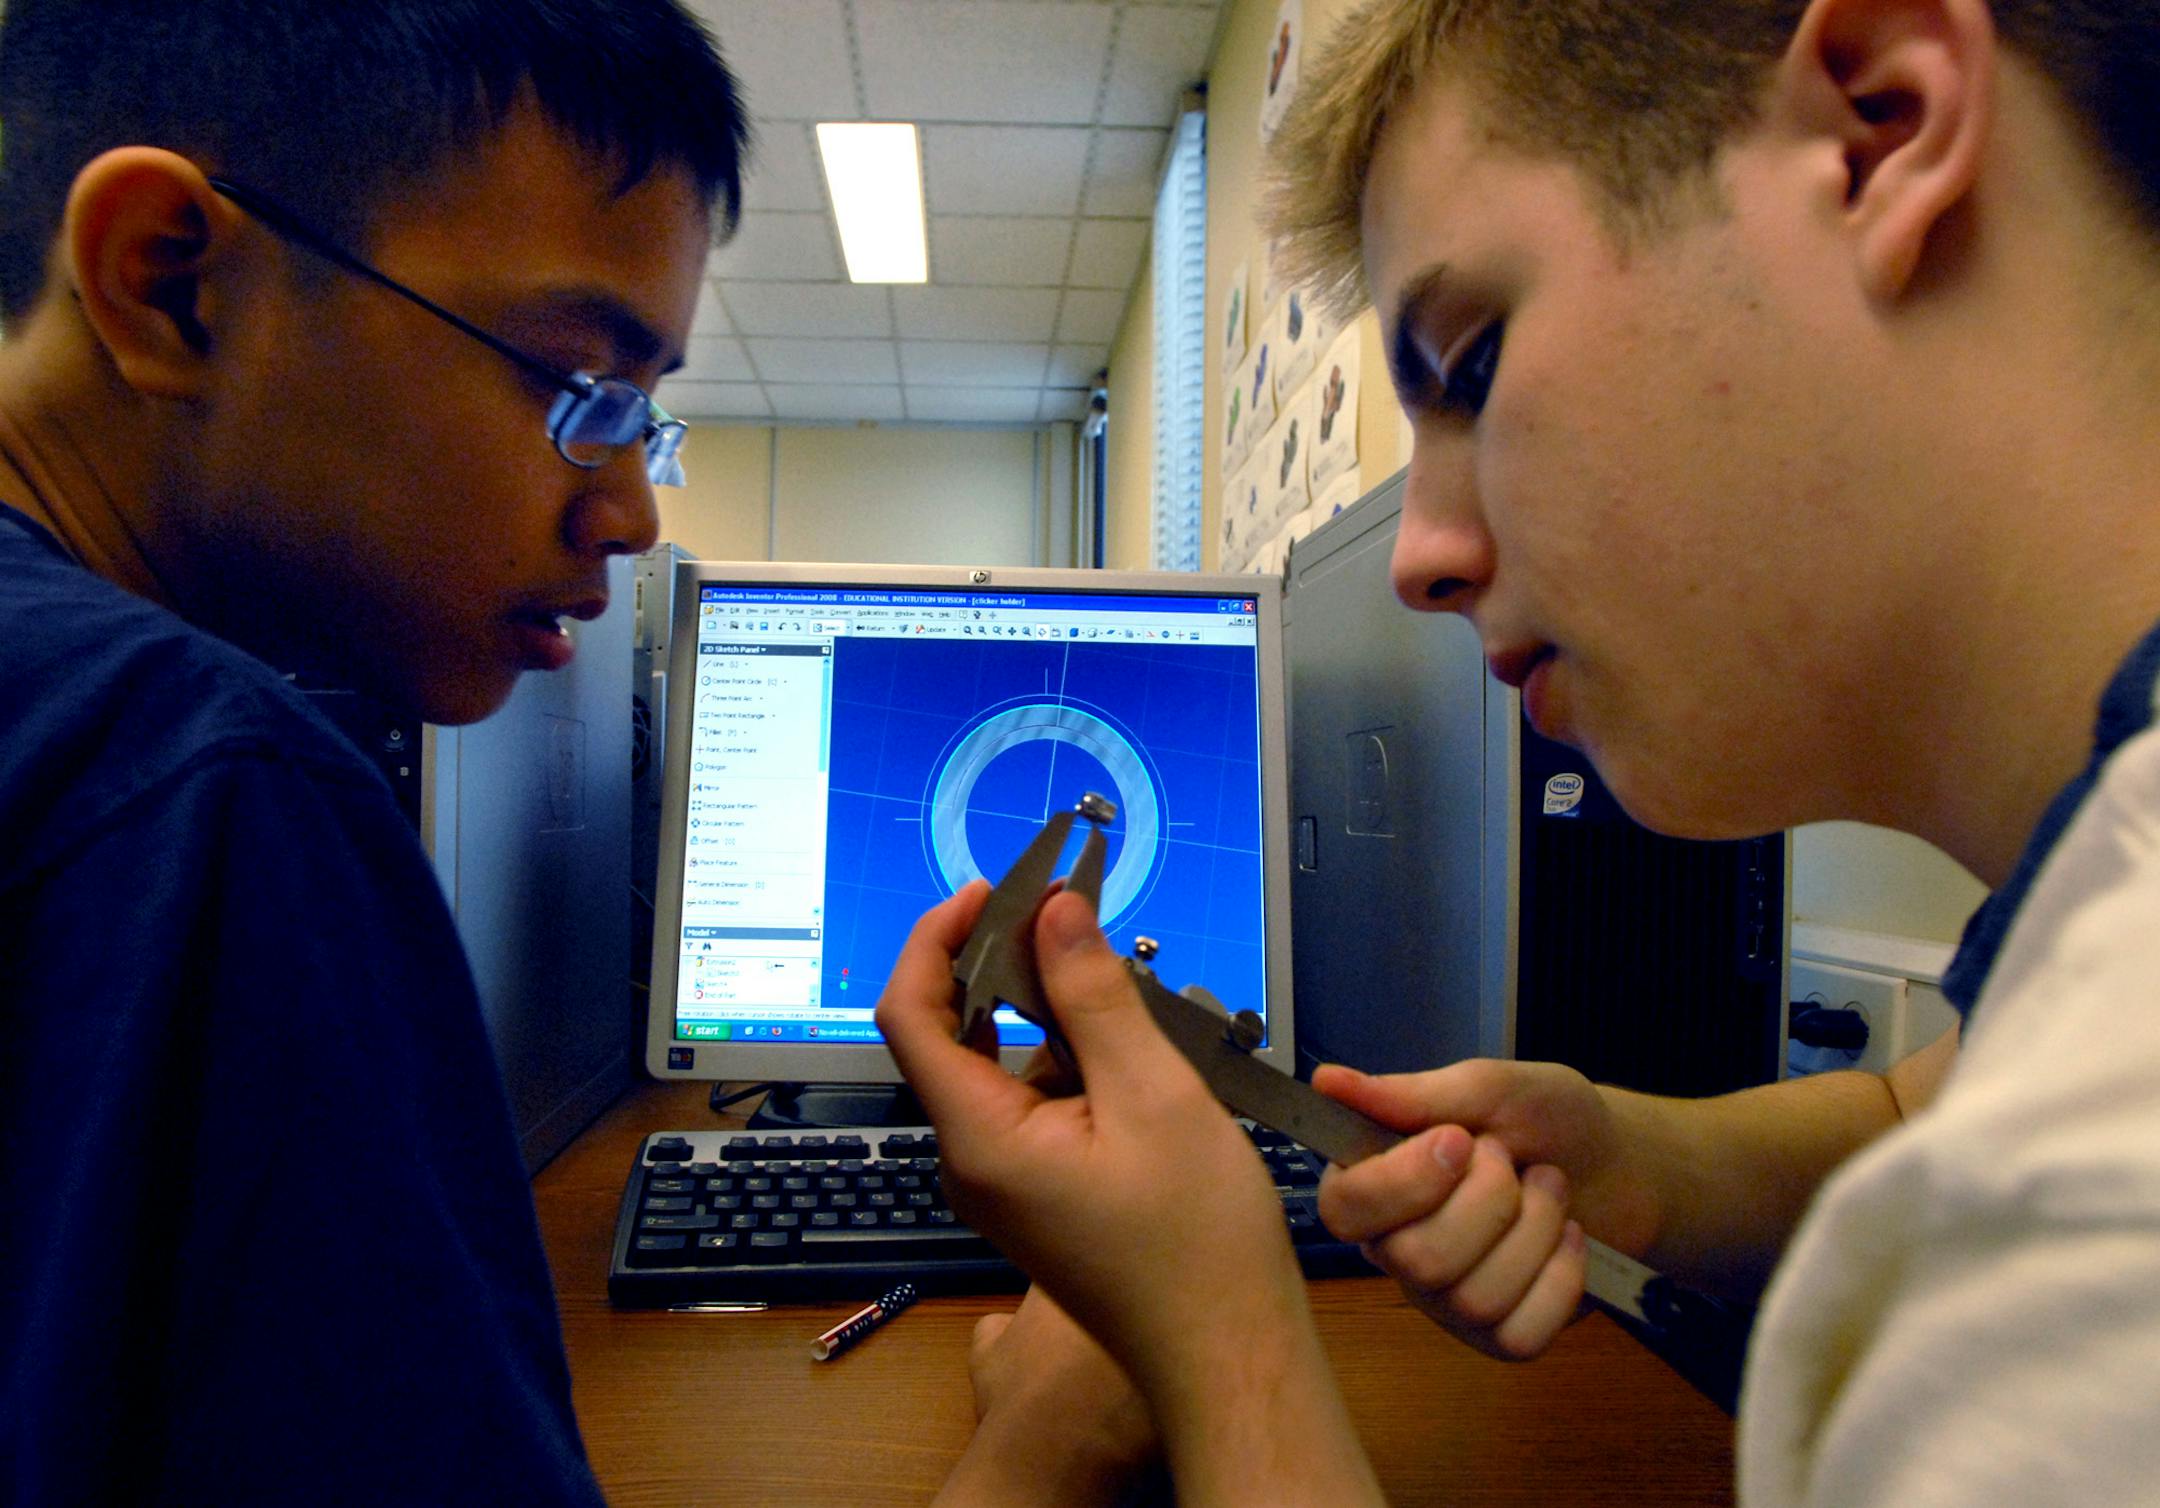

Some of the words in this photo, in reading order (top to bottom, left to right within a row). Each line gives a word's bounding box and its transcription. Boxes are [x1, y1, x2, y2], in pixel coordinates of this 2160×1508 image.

[713, 592, 744, 600] Autodesk
[745, 592, 774, 600] Inventor
[776, 592, 818, 601] Professional
[892, 595, 936, 603] INSTITUTION
[937, 596, 966, 604] VERSION
[715, 645, 739, 653] Sketch
[740, 646, 760, 654] Panel
[1552, 780, 1576, 790] intel
[686, 928, 710, 937] Model
[695, 1026, 720, 1035] start
